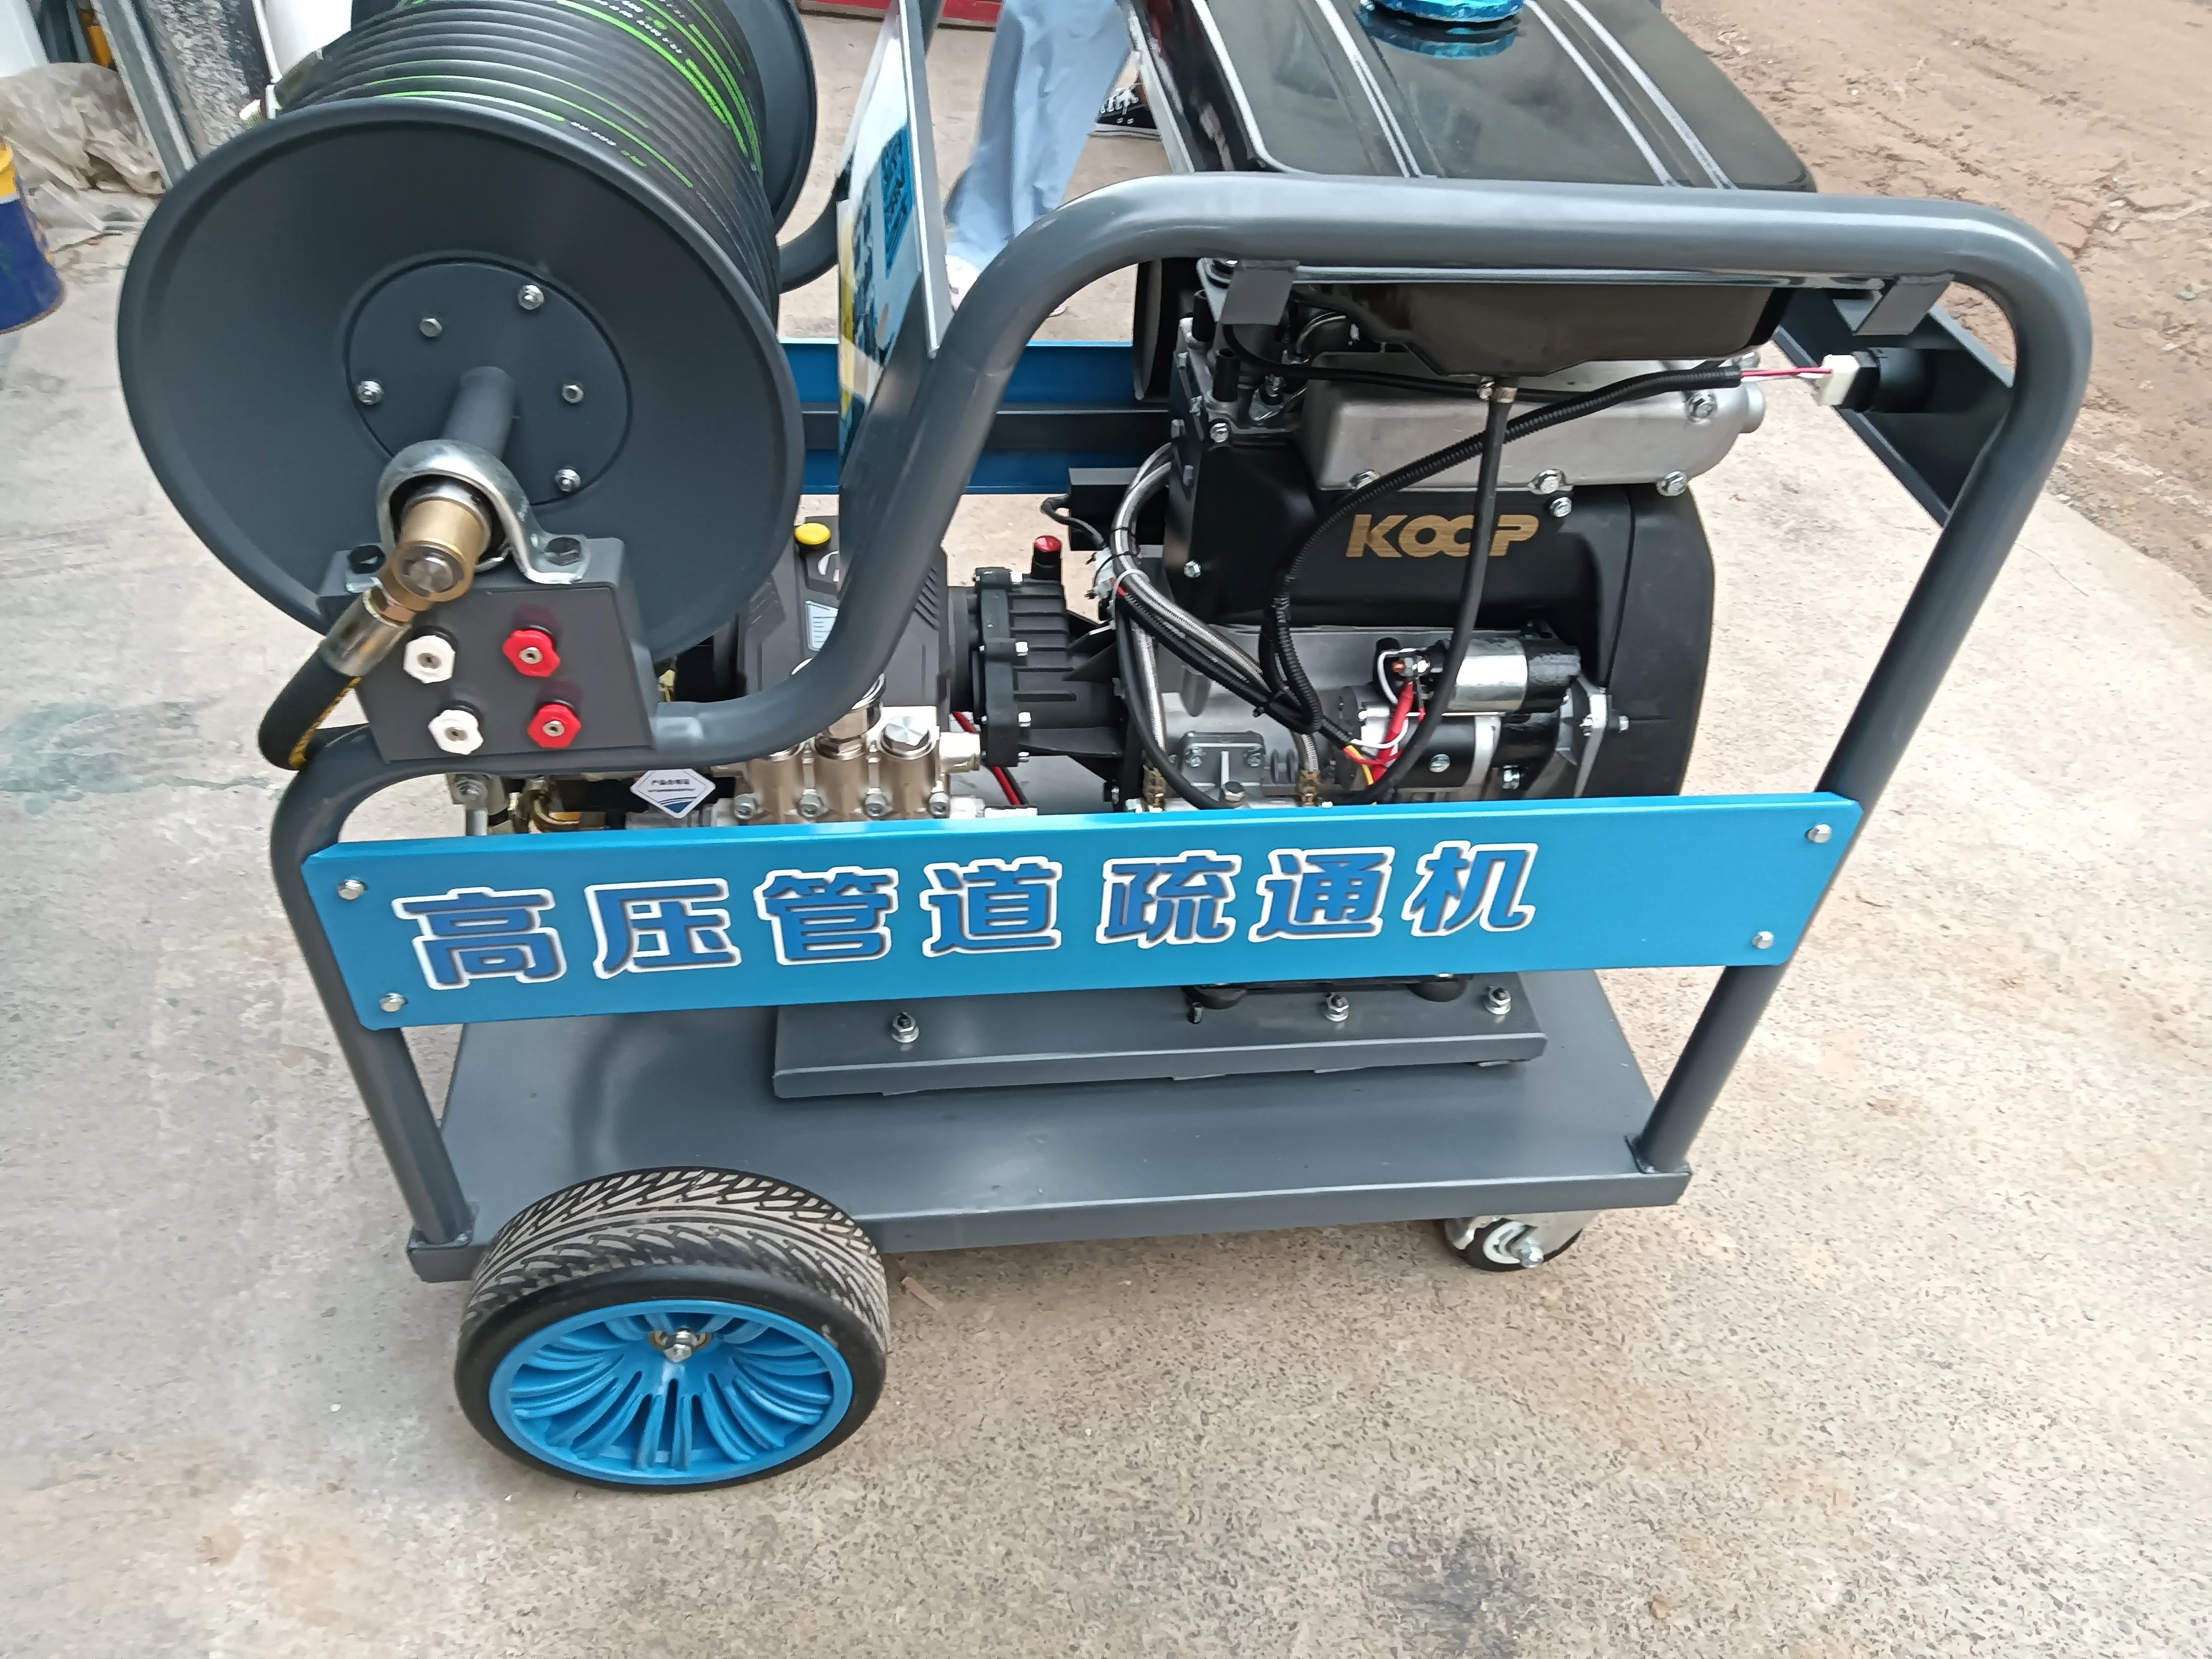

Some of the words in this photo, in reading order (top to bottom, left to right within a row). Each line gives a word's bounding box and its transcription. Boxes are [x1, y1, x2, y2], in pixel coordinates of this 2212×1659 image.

[391, 840, 1538, 990] 高压管道疏通机
